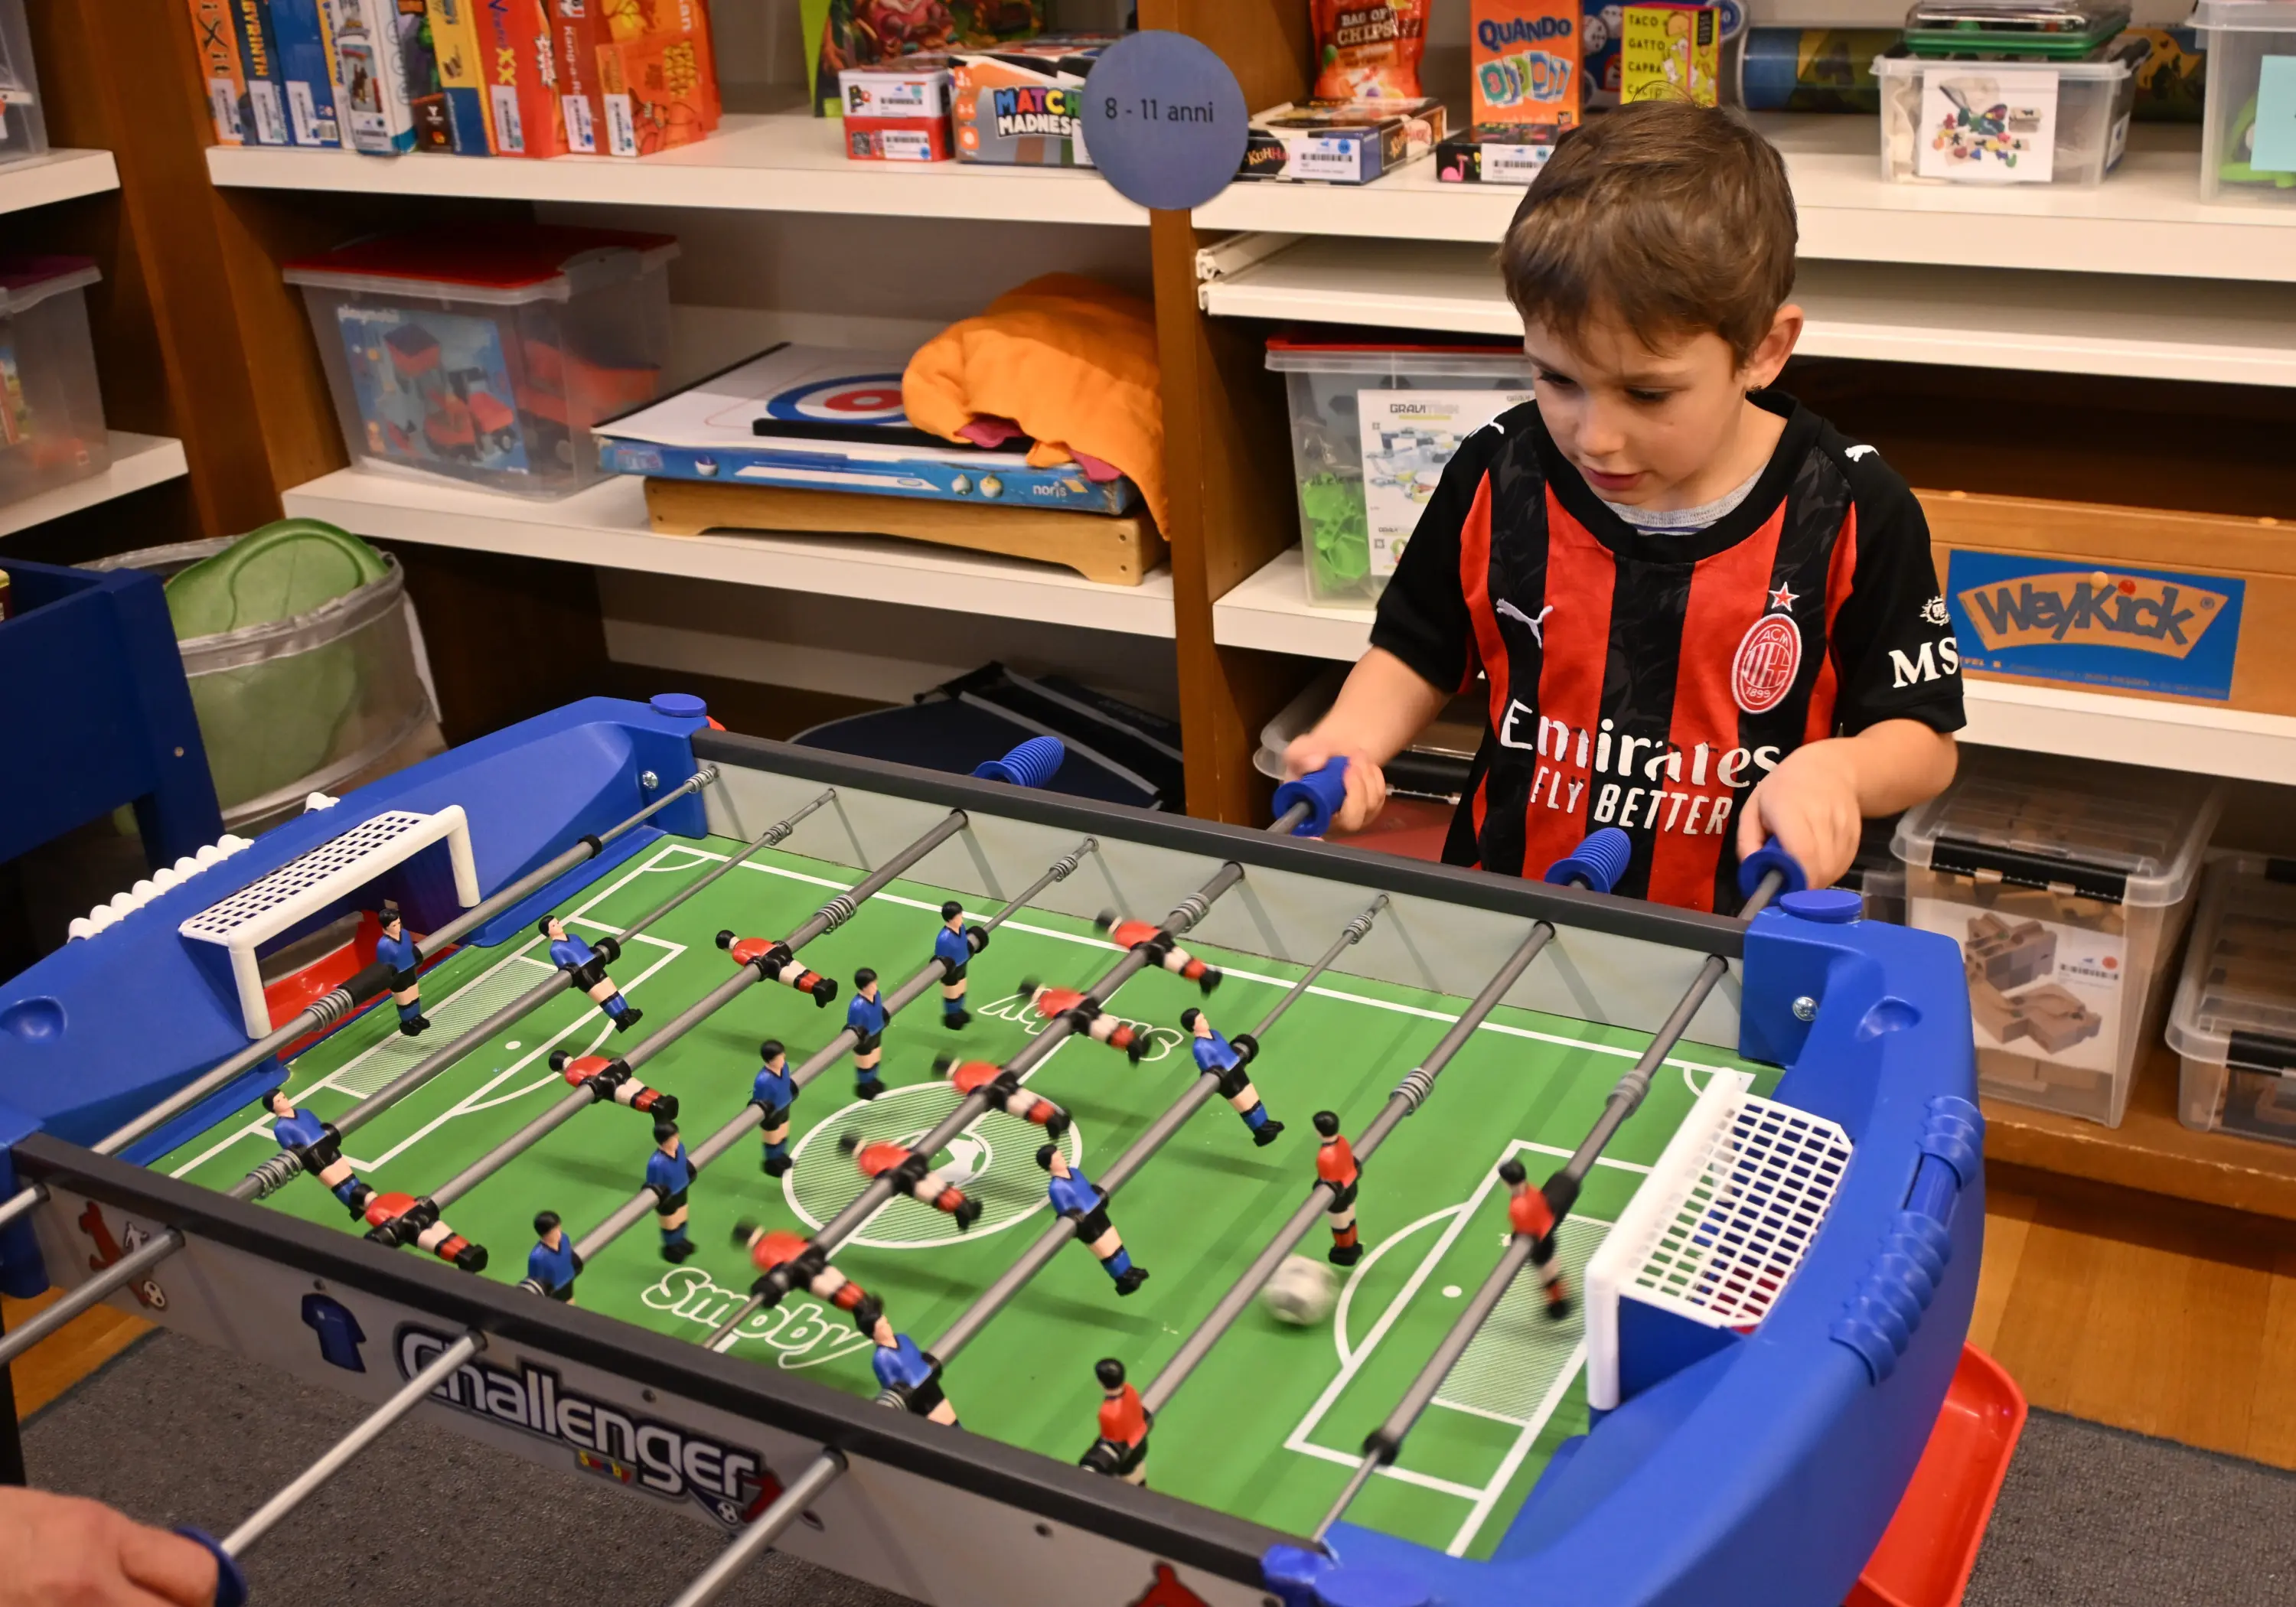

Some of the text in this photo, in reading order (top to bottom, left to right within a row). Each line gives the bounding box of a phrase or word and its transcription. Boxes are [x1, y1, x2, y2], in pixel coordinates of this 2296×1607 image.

[1336, 20, 1395, 46] CHIPS
[1478, 16, 1572, 52] QUANDO
[1628, 15, 1659, 27] TACO
[240, 0, 269, 76] BYRINTH
[1628, 38, 1665, 51] GATTO
[1627, 62, 1662, 74] CAPRA
[994, 87, 1081, 117] MATCH
[1105, 96, 1117, 119] 8
[1140, 98, 1158, 120] 11
[1167, 101, 1214, 123] anni
[1032, 481, 1068, 499] noris
[1973, 579, 2195, 646] WeyKick
[1760, 628, 1789, 647] ACM
[1744, 686, 1771, 699] 1899
[1500, 699, 1782, 788] Emirates
[1530, 766, 1733, 836] FLY BETTER
